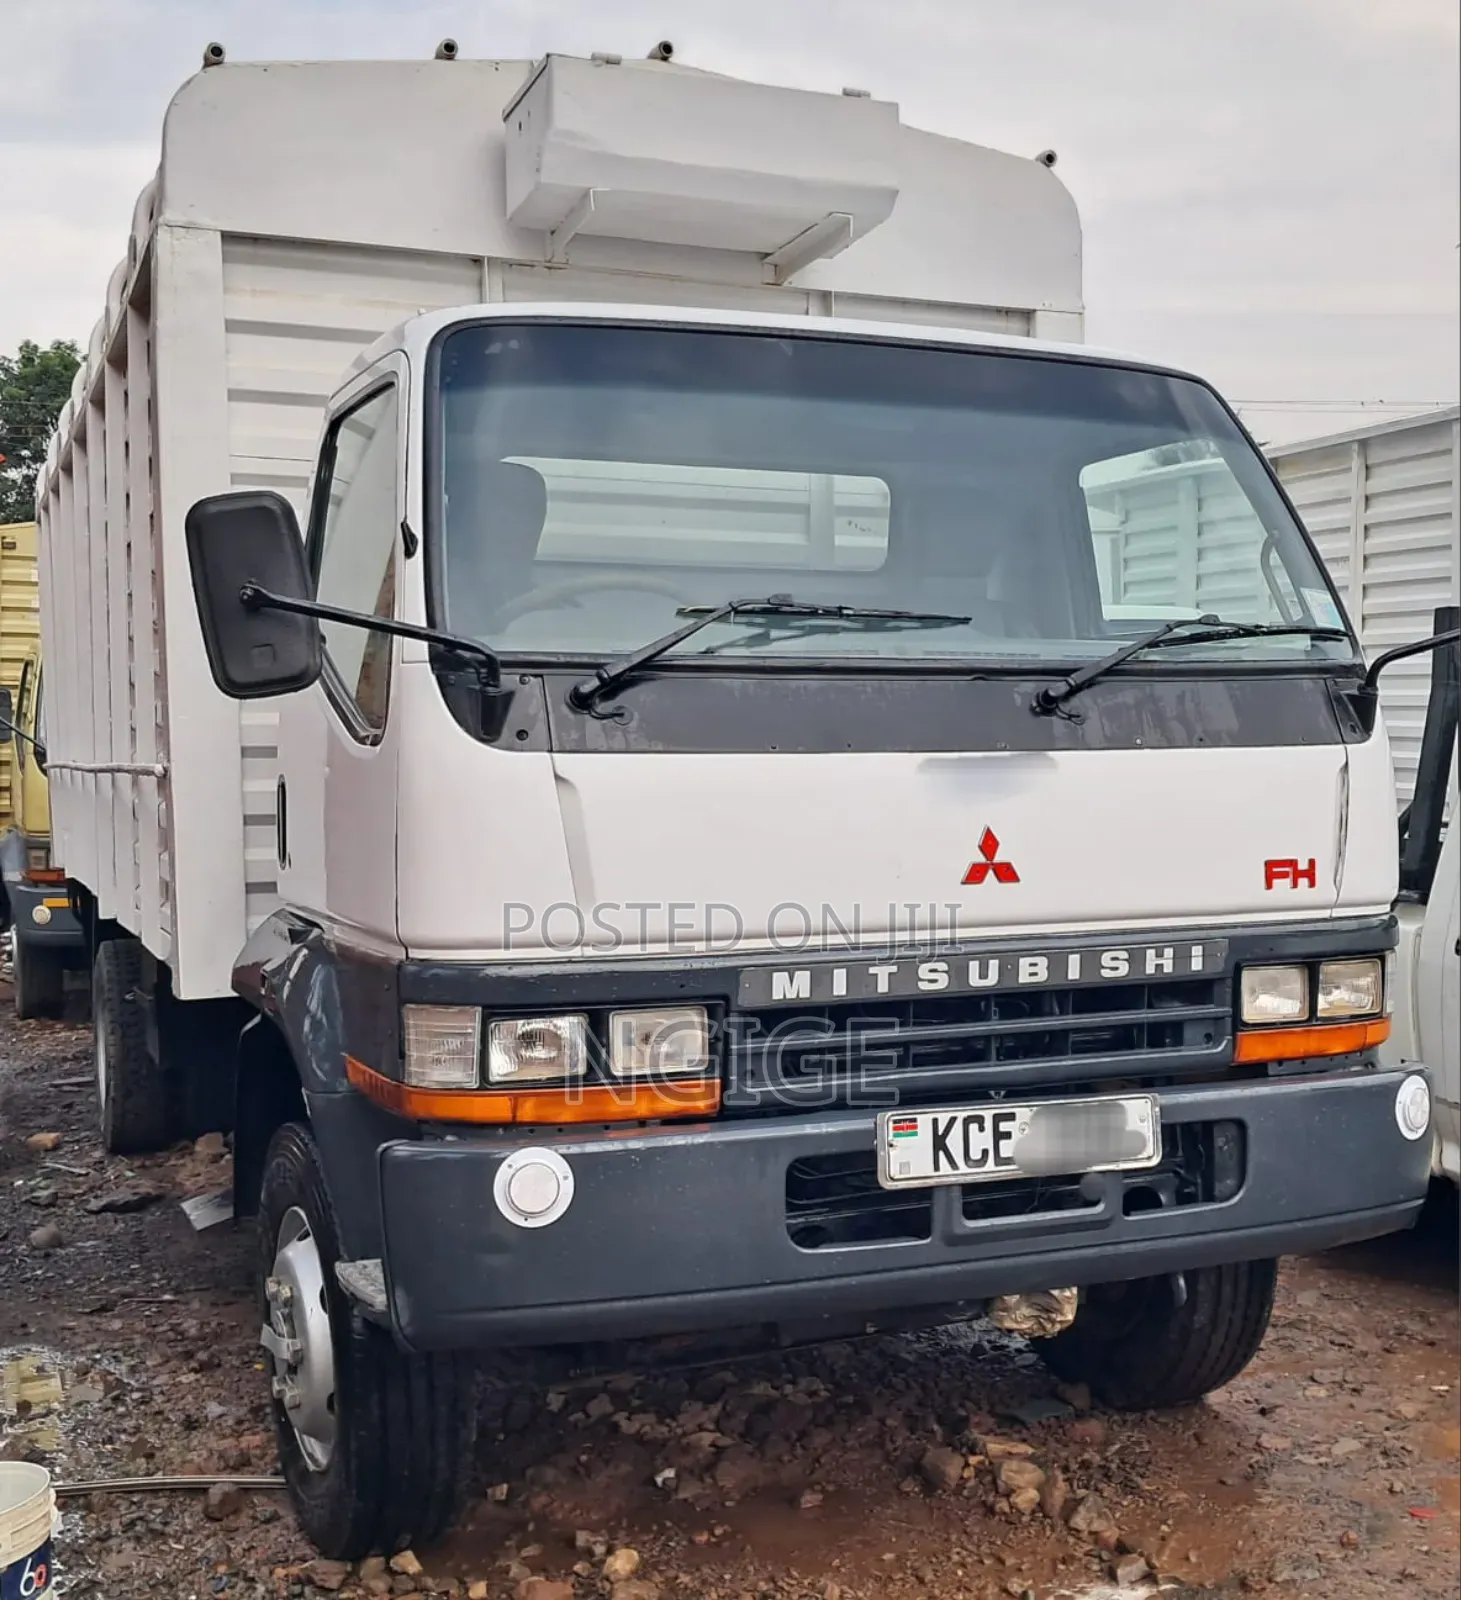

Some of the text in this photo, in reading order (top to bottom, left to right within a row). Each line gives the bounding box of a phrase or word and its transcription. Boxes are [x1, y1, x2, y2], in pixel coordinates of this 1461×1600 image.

[1264, 858, 1317, 890] FH
[771, 944, 1205, 1001] MITSUBISHI
[931, 1111, 1017, 1173] KCE
